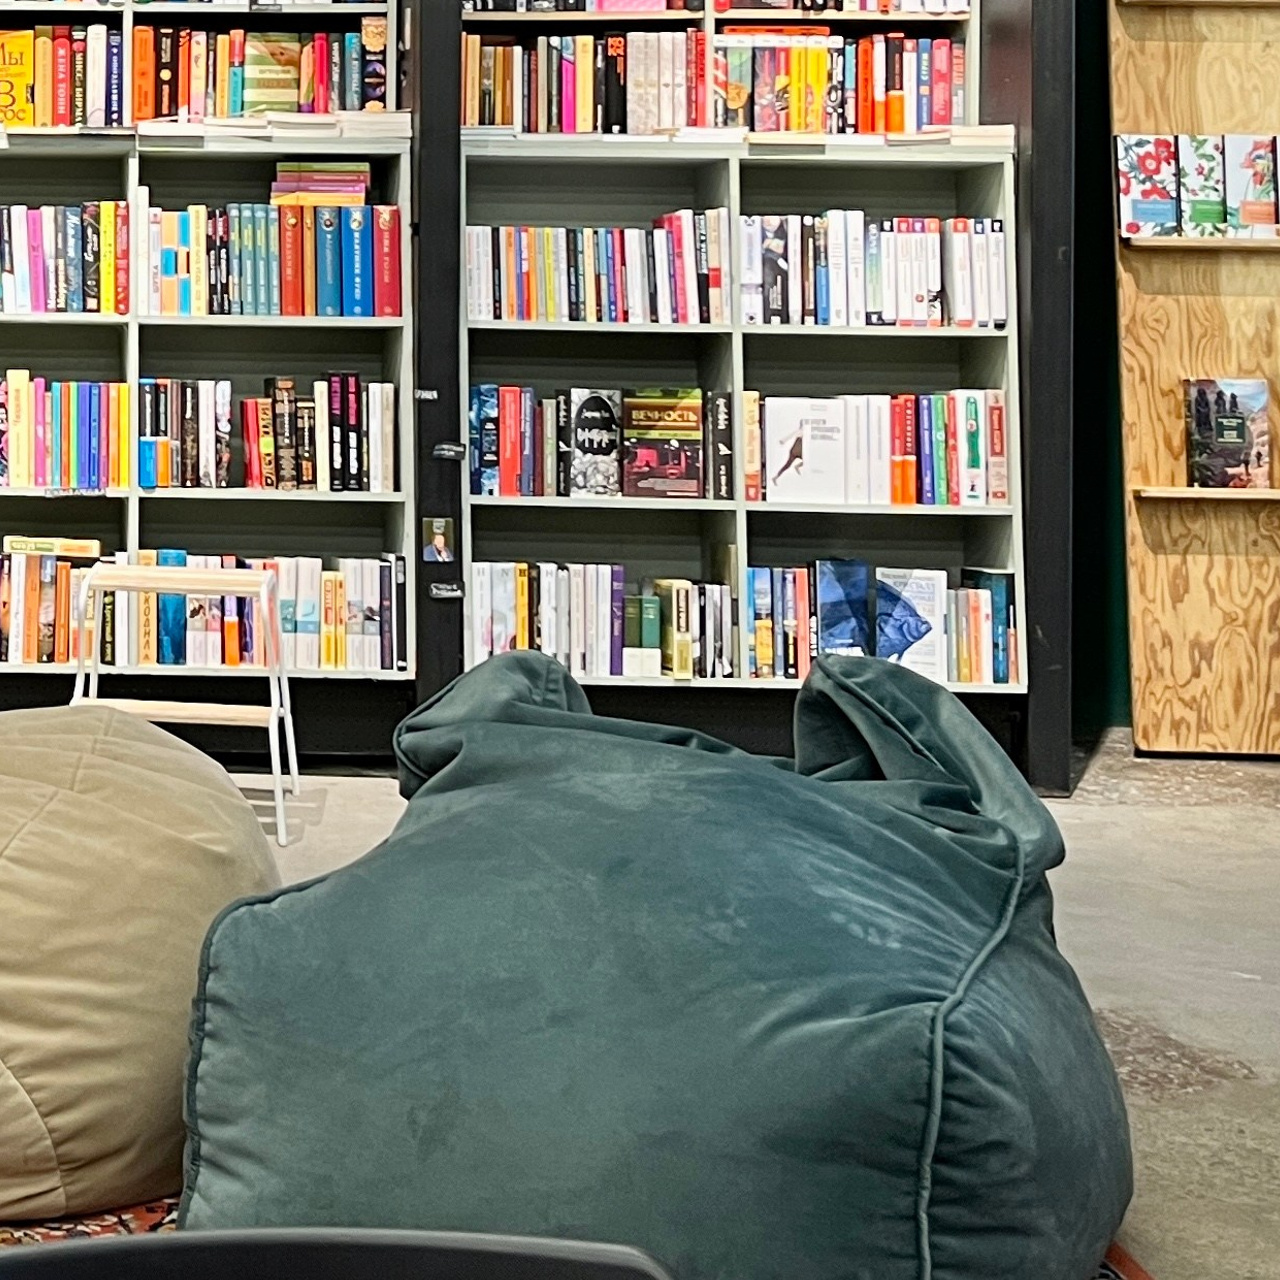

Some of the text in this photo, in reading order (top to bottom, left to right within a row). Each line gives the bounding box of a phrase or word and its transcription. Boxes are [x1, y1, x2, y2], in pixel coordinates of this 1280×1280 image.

[57, 48, 66, 114] ЖЕНА ТОНИ
[74, 87, 83, 123] БИРМА
[631, 410, 698, 423] ВЕЧНОСТЬ
